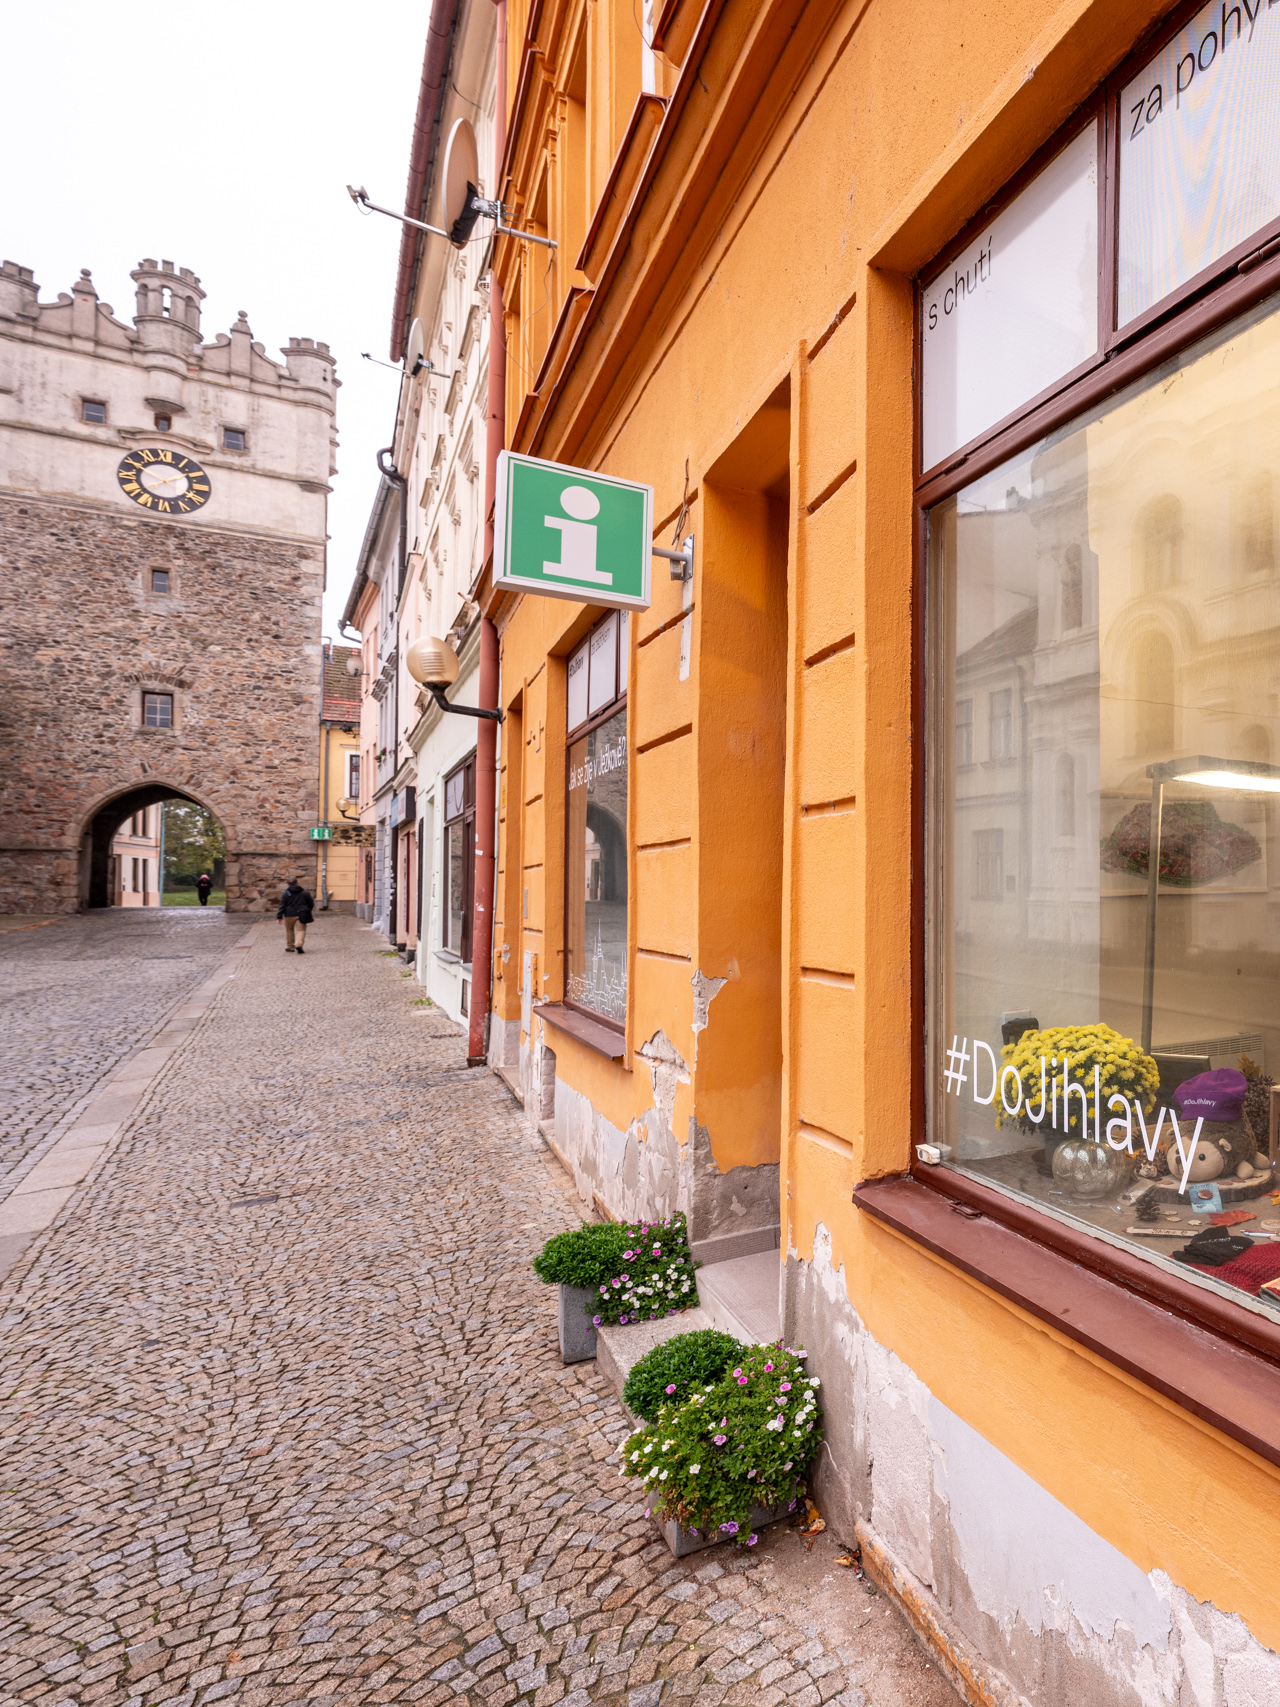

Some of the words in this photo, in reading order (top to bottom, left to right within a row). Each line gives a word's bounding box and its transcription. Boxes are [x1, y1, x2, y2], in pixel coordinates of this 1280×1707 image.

[1130, 84, 1163, 141] za
[1176, 0, 1280, 110] pohy
[929, 303, 938, 330] s
[943, 235, 992, 315] chutí
[578, 767, 584, 786] se
[943, 1035, 1204, 1195] #DoJihlavy
